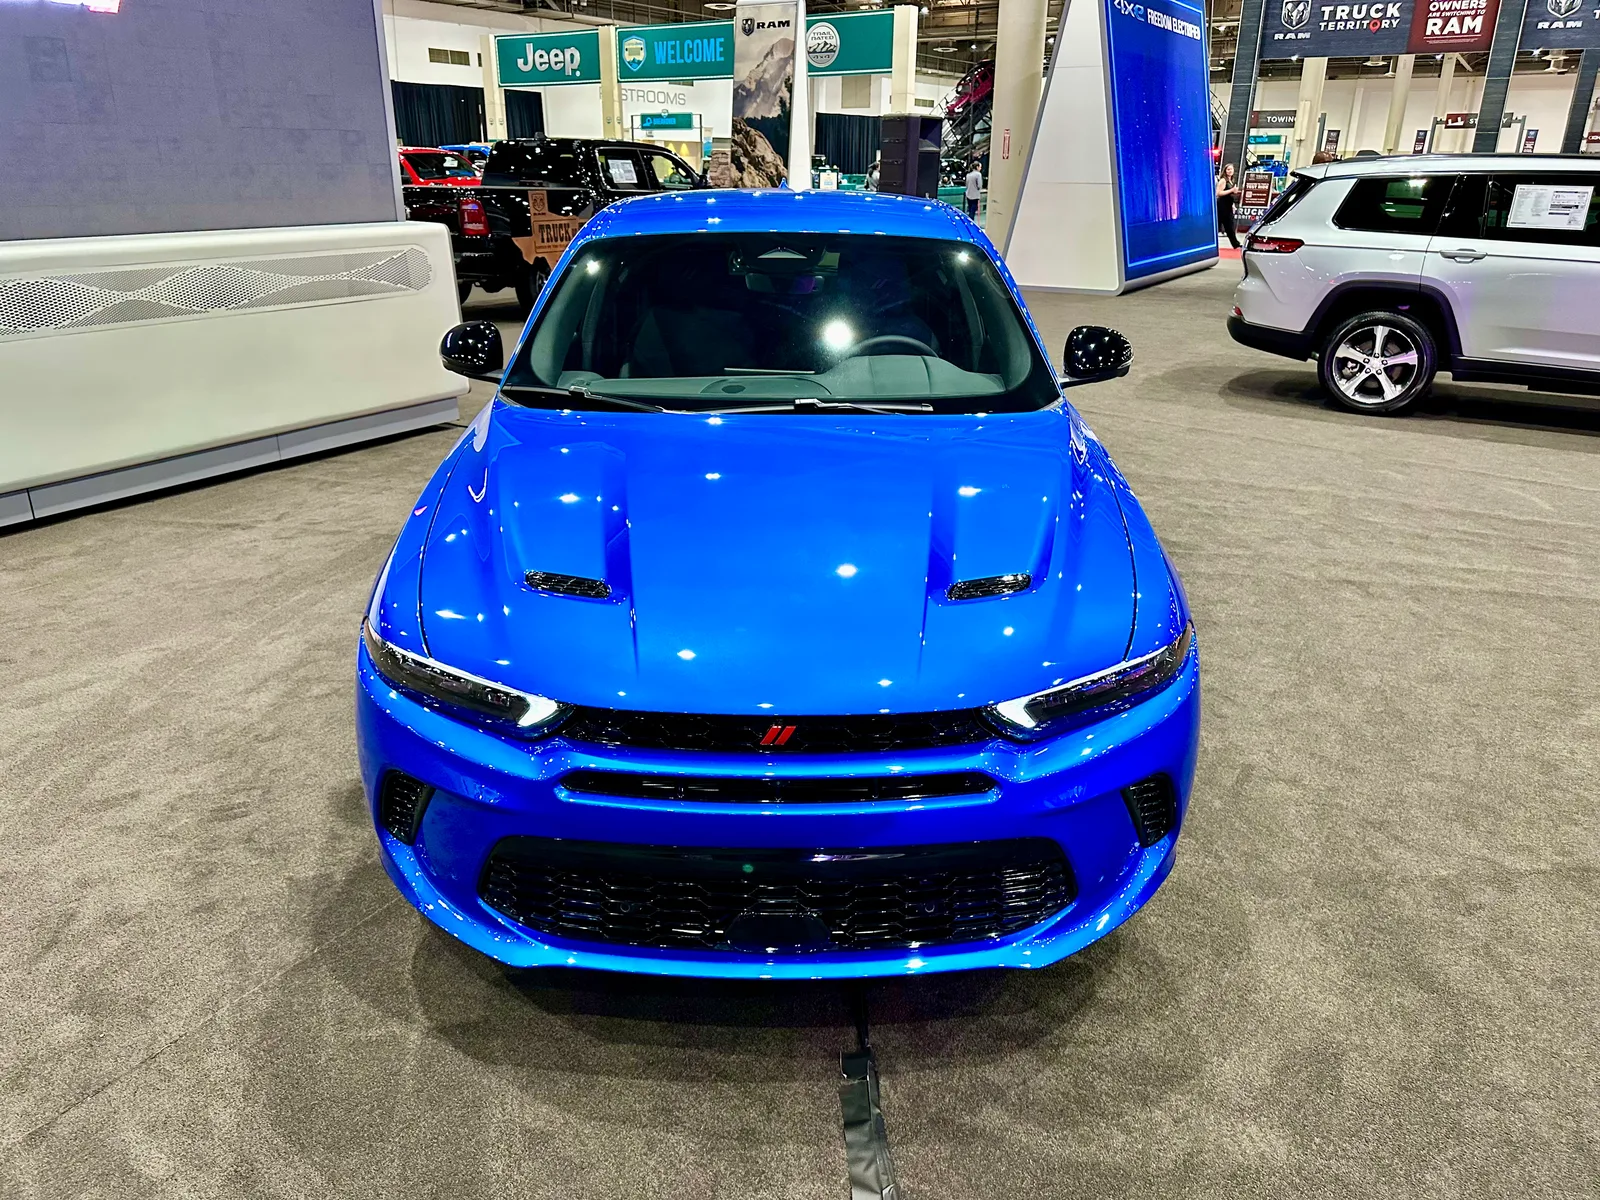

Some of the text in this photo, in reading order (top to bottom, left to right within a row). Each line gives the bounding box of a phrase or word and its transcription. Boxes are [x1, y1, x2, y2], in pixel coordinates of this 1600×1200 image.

[1320, 2, 1402, 20] TRUCK
[1429, 0, 1487, 11] OWNERS
[756, 20, 791, 30] RAM
[1147, 8, 1172, 31] FREEDOM
[1319, 19, 1400, 33] TERRITORY
[1426, 15, 1482, 35] RAM
[1537, 21, 1583, 29] RAM
[1273, 32, 1311, 40] RAM
[517, 43, 580, 76] Jeep
[653, 38, 725, 64] WELCOME
[599, 86, 686, 106] STROOMS
[538, 222, 571, 243] TRUCK
